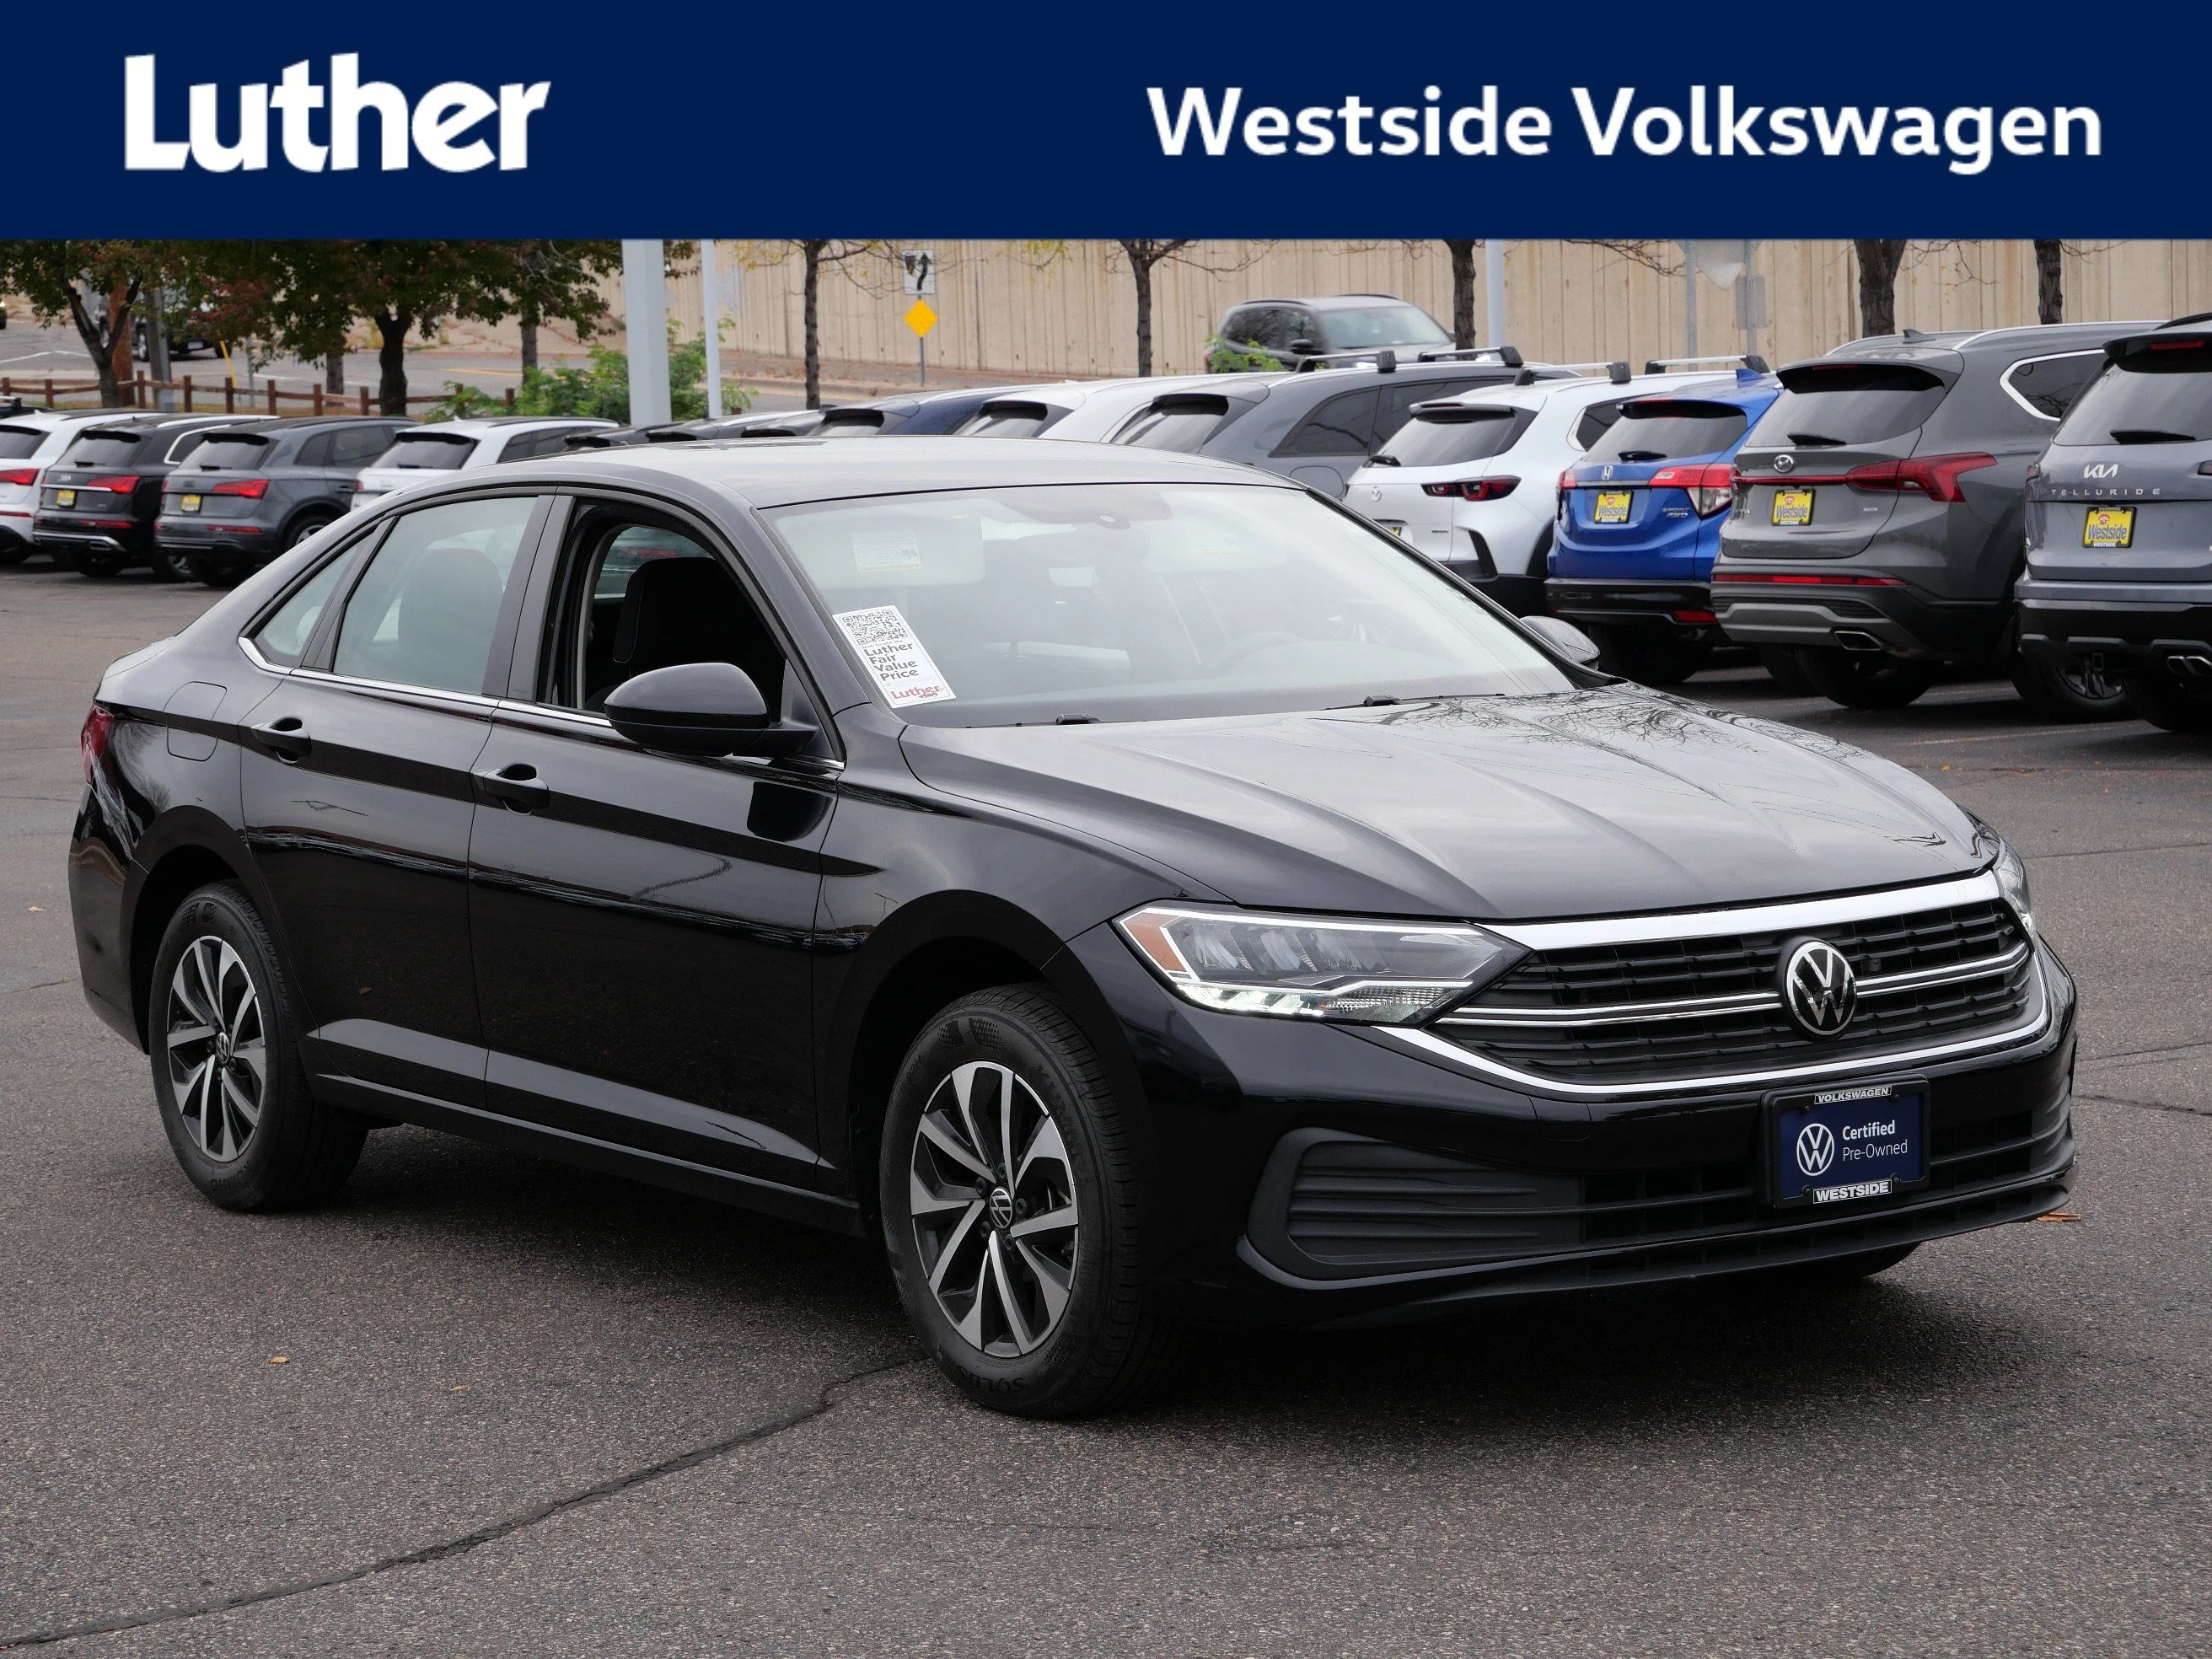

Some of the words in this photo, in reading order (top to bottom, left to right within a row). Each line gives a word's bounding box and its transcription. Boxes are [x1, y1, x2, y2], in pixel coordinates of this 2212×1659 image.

[1776, 505, 1808, 518] Westside
[2088, 523, 2127, 540] Westside
[863, 643, 913, 657] Luther
[868, 654, 896, 664] Fair
[873, 661, 917, 672] Value
[879, 669, 919, 681] Price
[890, 685, 940, 699] Luther
[1817, 1087, 1890, 1104] VOLKSWAGEN
[1842, 1119, 1896, 1141] Certified
[1843, 1138, 1909, 1162] Pre-Owned
[1816, 1180, 1890, 1203] WESTSIDE
